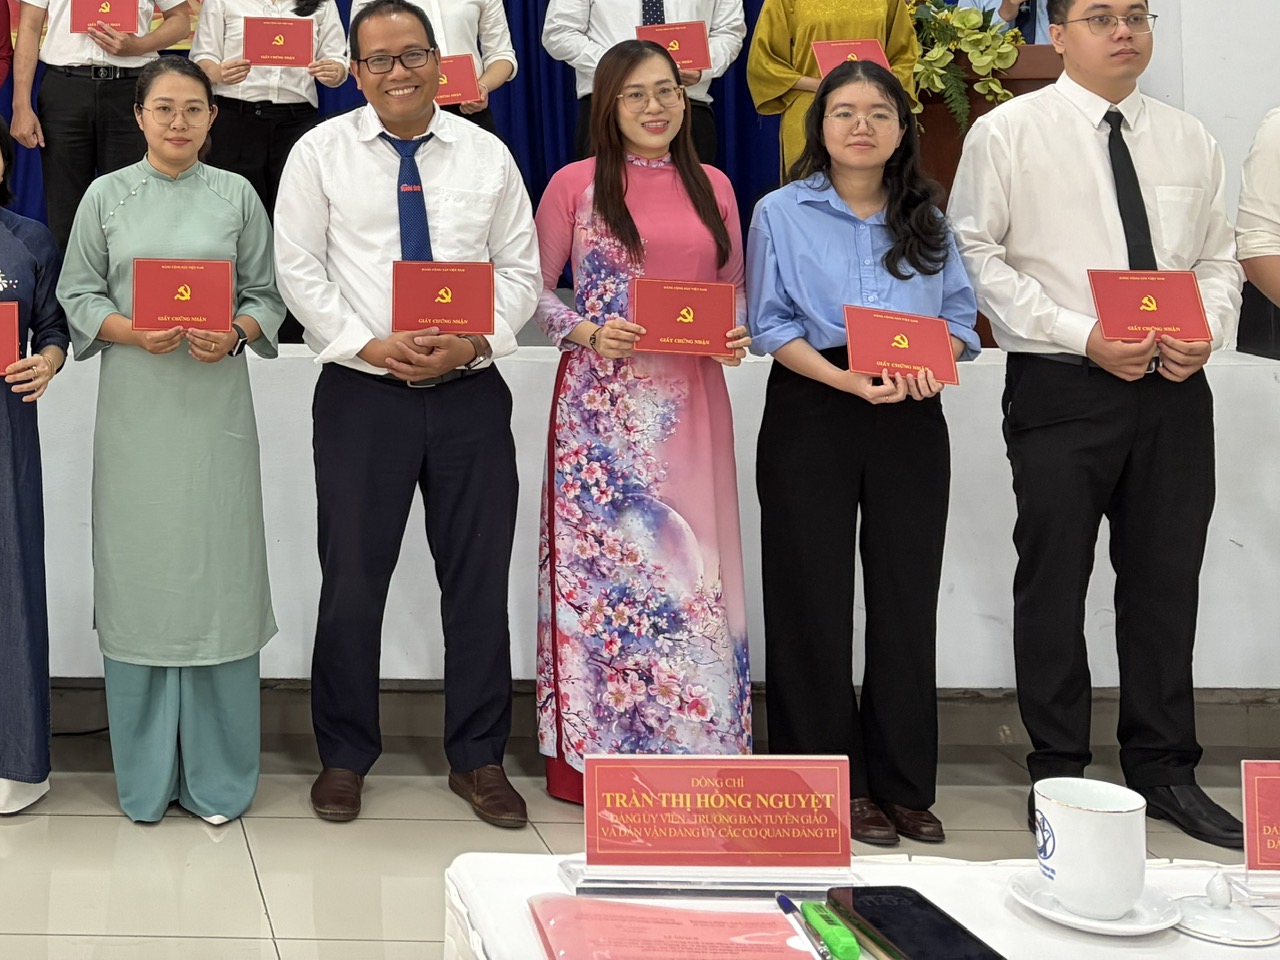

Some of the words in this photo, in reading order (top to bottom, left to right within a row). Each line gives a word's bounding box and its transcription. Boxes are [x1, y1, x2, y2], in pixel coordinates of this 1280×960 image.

[602, 788, 655, 809] TRẦN
[658, 792, 692, 812] THỊ
[739, 814, 762, 825] BAN
[759, 827, 791, 840] QUAN
[824, 828, 838, 839] TP
